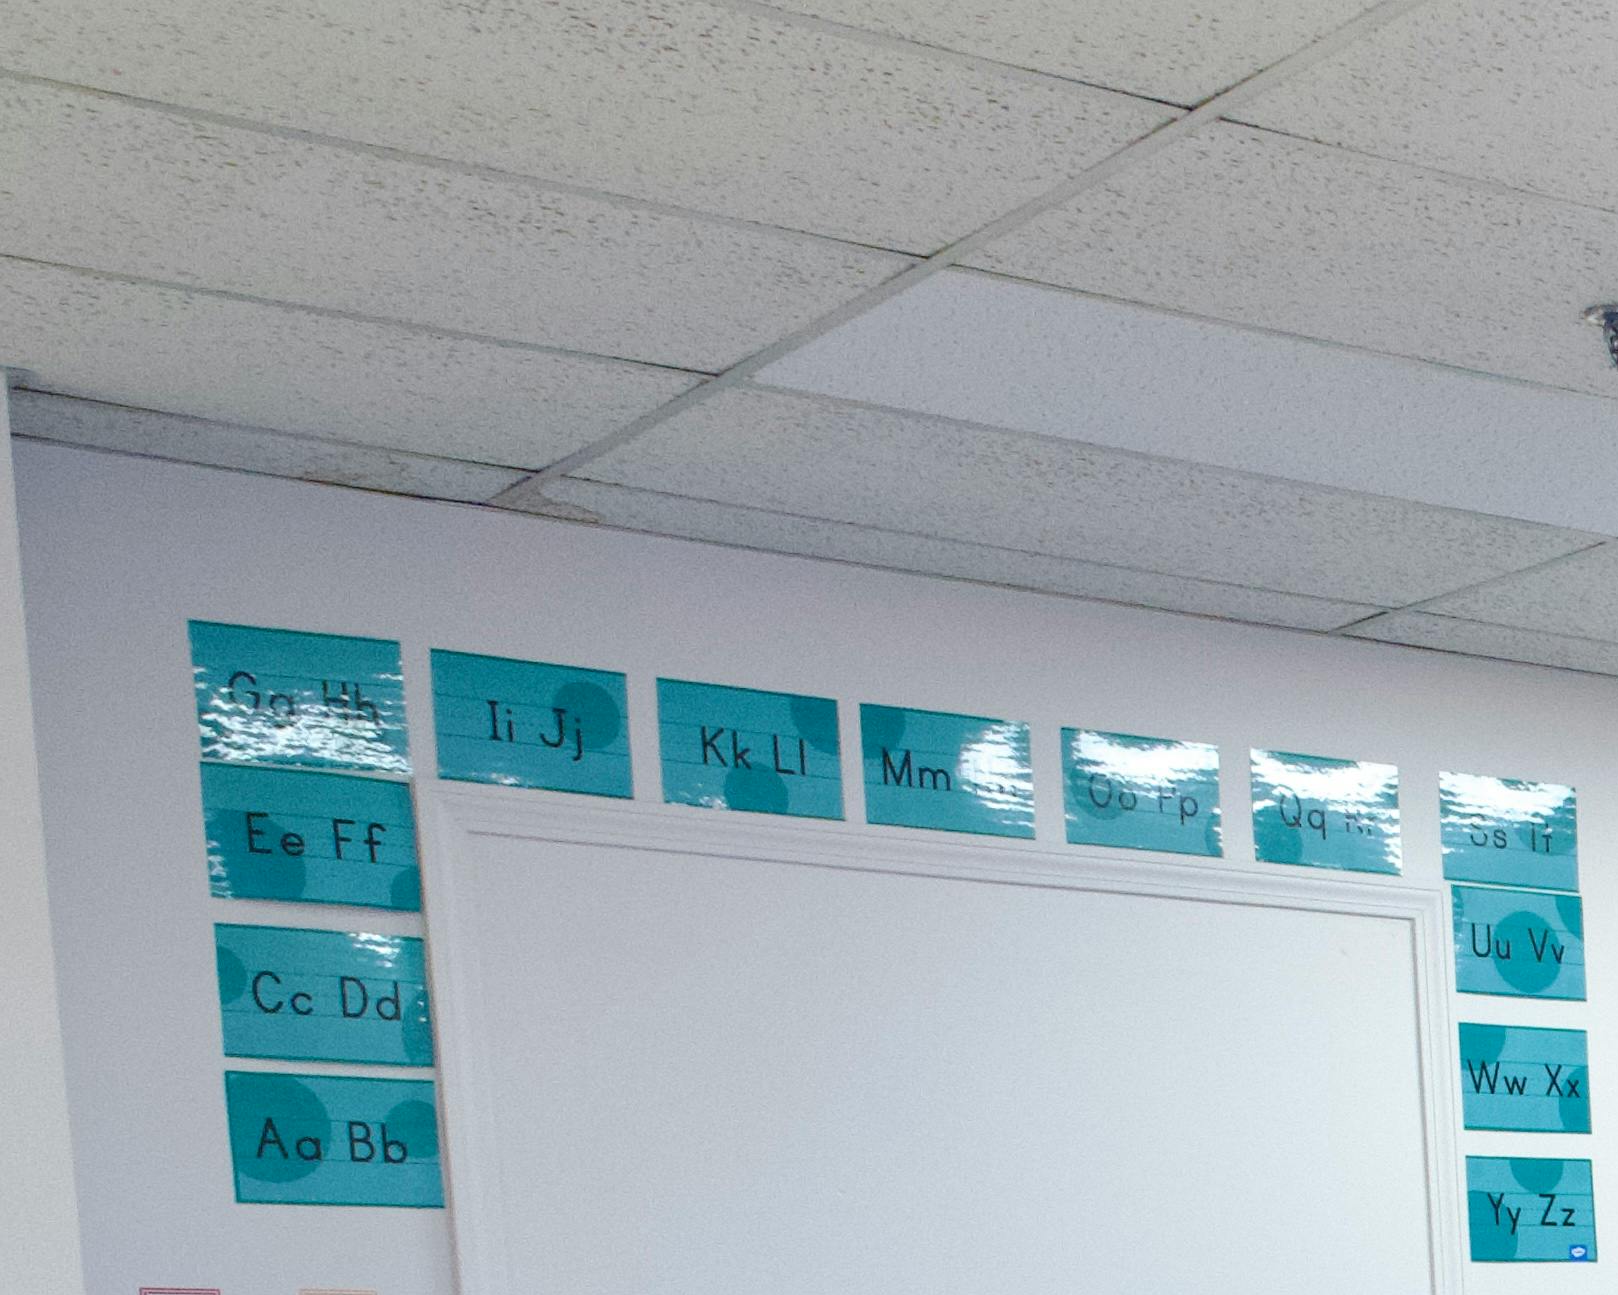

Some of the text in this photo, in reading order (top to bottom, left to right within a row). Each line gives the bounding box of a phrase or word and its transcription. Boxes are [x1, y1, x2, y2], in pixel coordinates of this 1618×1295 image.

[486, 699, 585, 764] Ii Jj
[700, 725, 808, 776] Kk Ll
[880, 749, 952, 793] Mm
[1088, 772, 1138, 811] Oo
[1277, 784, 1327, 841] Qq
[246, 813, 388, 865] Ee Ff
[1469, 924, 1566, 966] Uu Vv
[251, 972, 402, 1022] Cc Dd
[1466, 1060, 1581, 1099] Ww Xx
[255, 1117, 409, 1165] Aa Bb
[1486, 1194, 1578, 1236] Yy Zz
